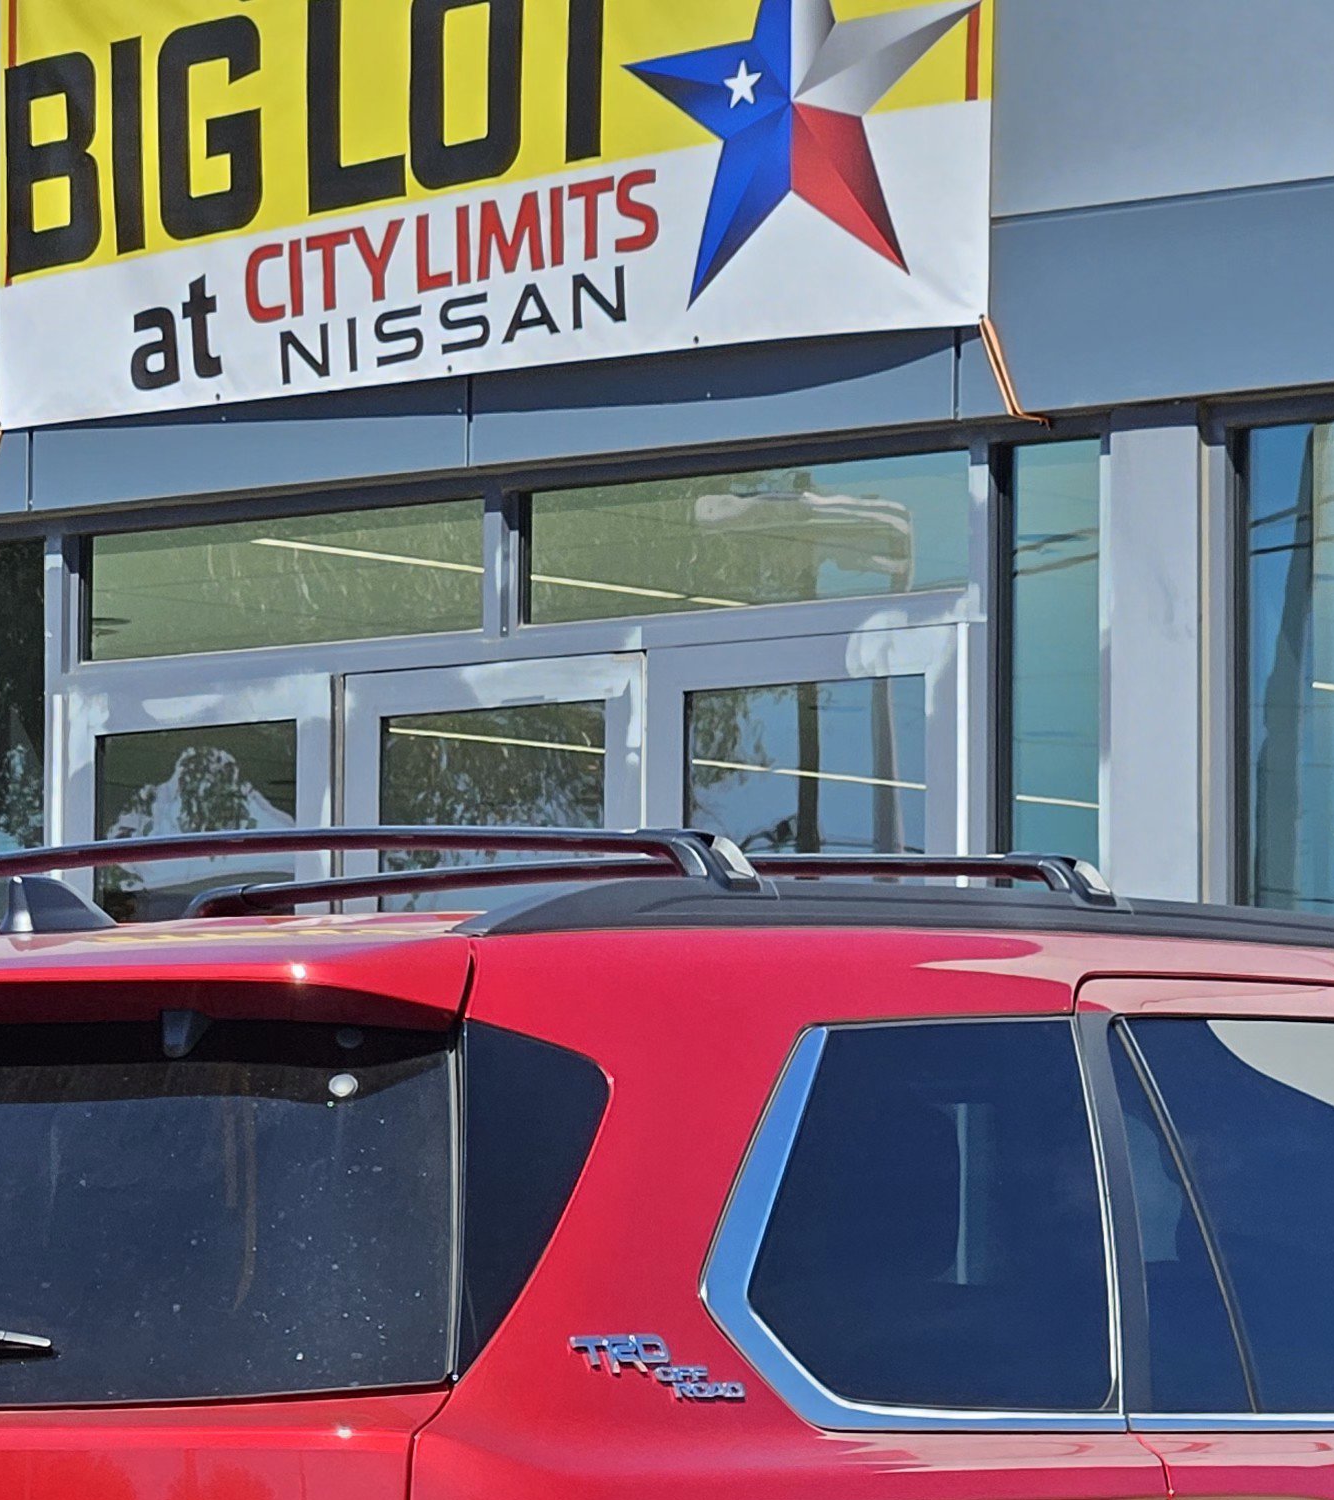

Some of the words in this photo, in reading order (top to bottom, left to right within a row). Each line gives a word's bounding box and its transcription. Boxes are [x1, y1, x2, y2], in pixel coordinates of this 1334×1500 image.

[5, 14, 264, 278] BIG
[130, 273, 223, 391] at
[244, 217, 405, 323] CITY
[416, 168, 659, 294] LIMITS
[279, 265, 628, 385] NISSAN
[569, 1334, 671, 1374] TRD
[653, 1366, 708, 1382] OFF
[673, 1381, 746, 1399] ROAD
